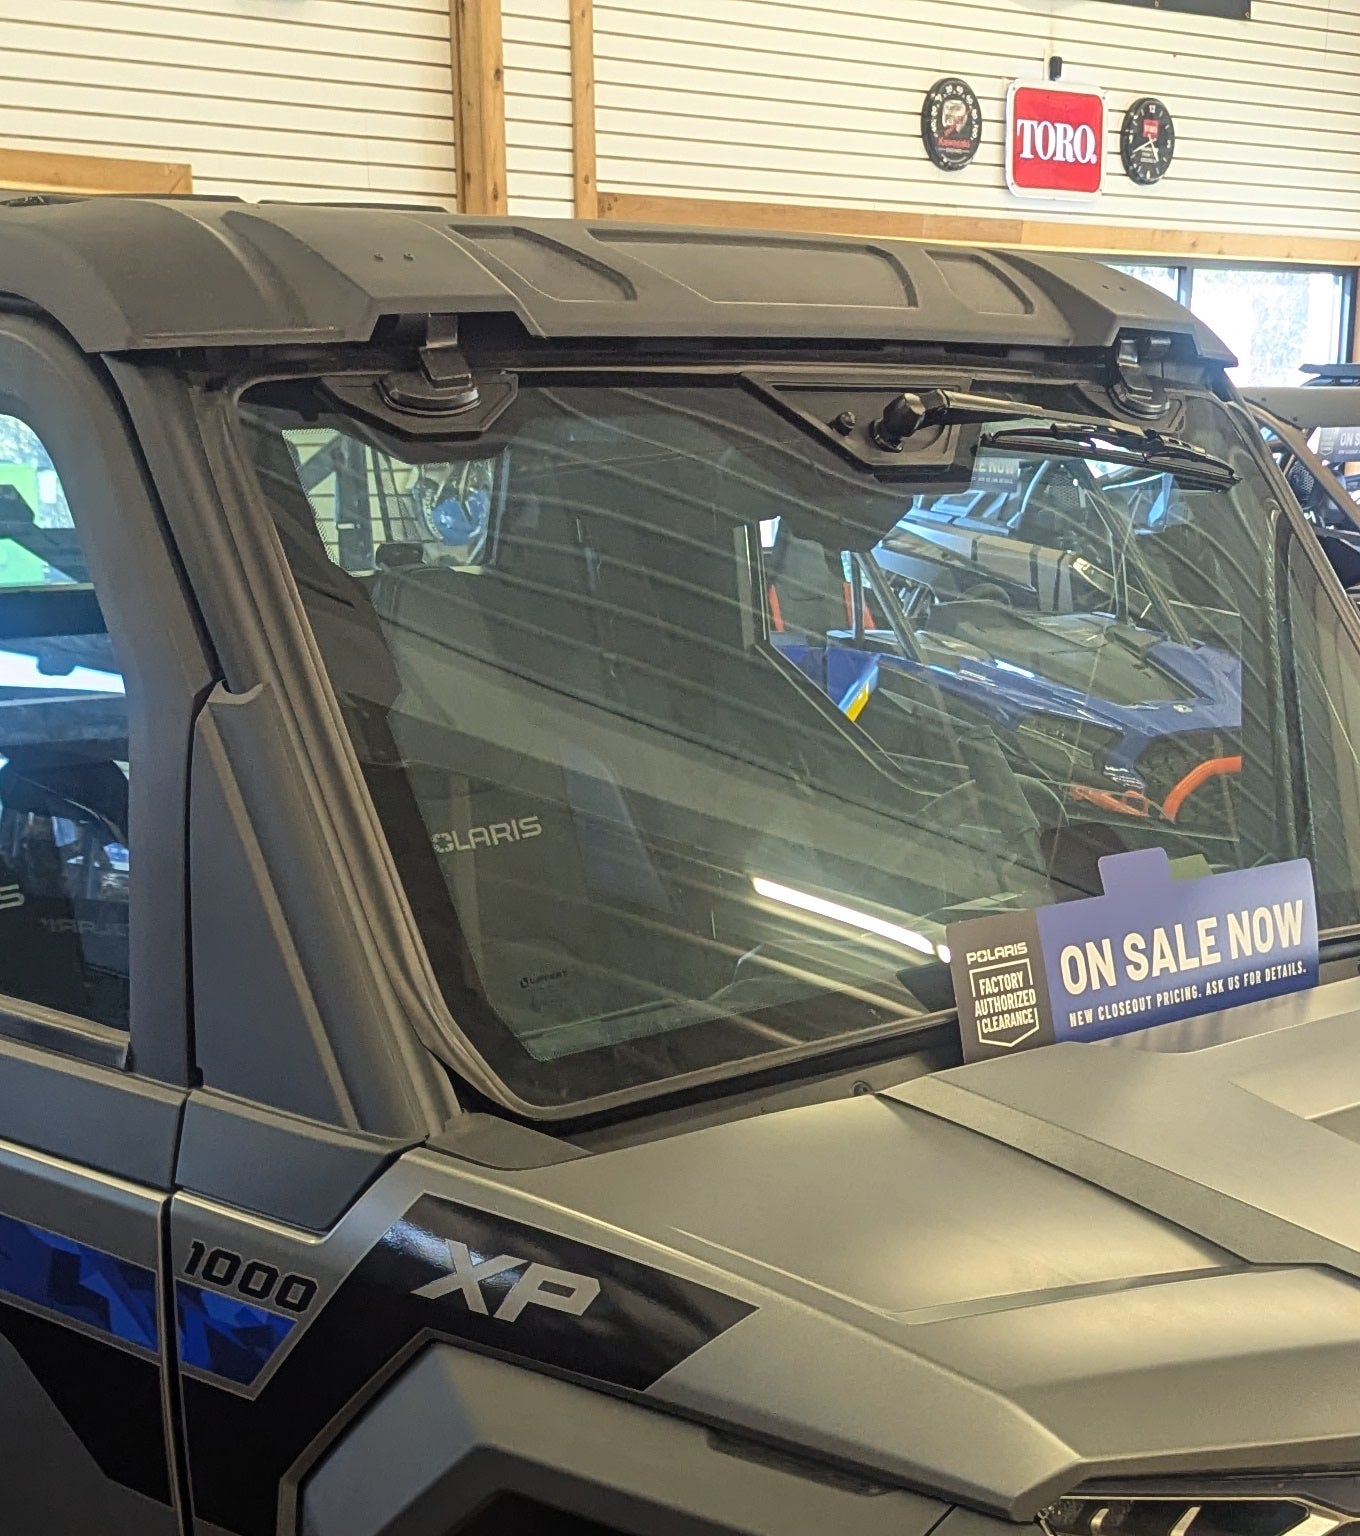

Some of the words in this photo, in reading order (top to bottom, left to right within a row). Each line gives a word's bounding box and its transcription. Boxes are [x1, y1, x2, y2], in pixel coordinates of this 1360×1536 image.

[1016, 119, 1096, 164] TORO
[1339, 432, 1354, 447] ON
[431, 815, 542, 854] OLARIS
[966, 941, 1028, 965] POLARIS
[1059, 937, 1117, 996] ON
[1125, 916, 1222, 982] SALE
[1226, 899, 1304, 959] NOW
[978, 971, 1025, 996] FACTORY
[1069, 1009, 1093, 1028] NEW
[1097, 996, 1152, 1023] CLOSEOUT
[1156, 985, 1202, 1008] PRICING.
[1205, 980, 1225, 996] ASK
[1227, 976, 1240, 991] US
[1243, 970, 1262, 988] FOR
[1265, 960, 1308, 984] DETAILS.
[975, 989, 1036, 1018] AUTHORIZED
[981, 1008, 1035, 1034] CLEARANCE
[184, 1239, 319, 1313] 1000
[410, 1238, 601, 1323] XP
